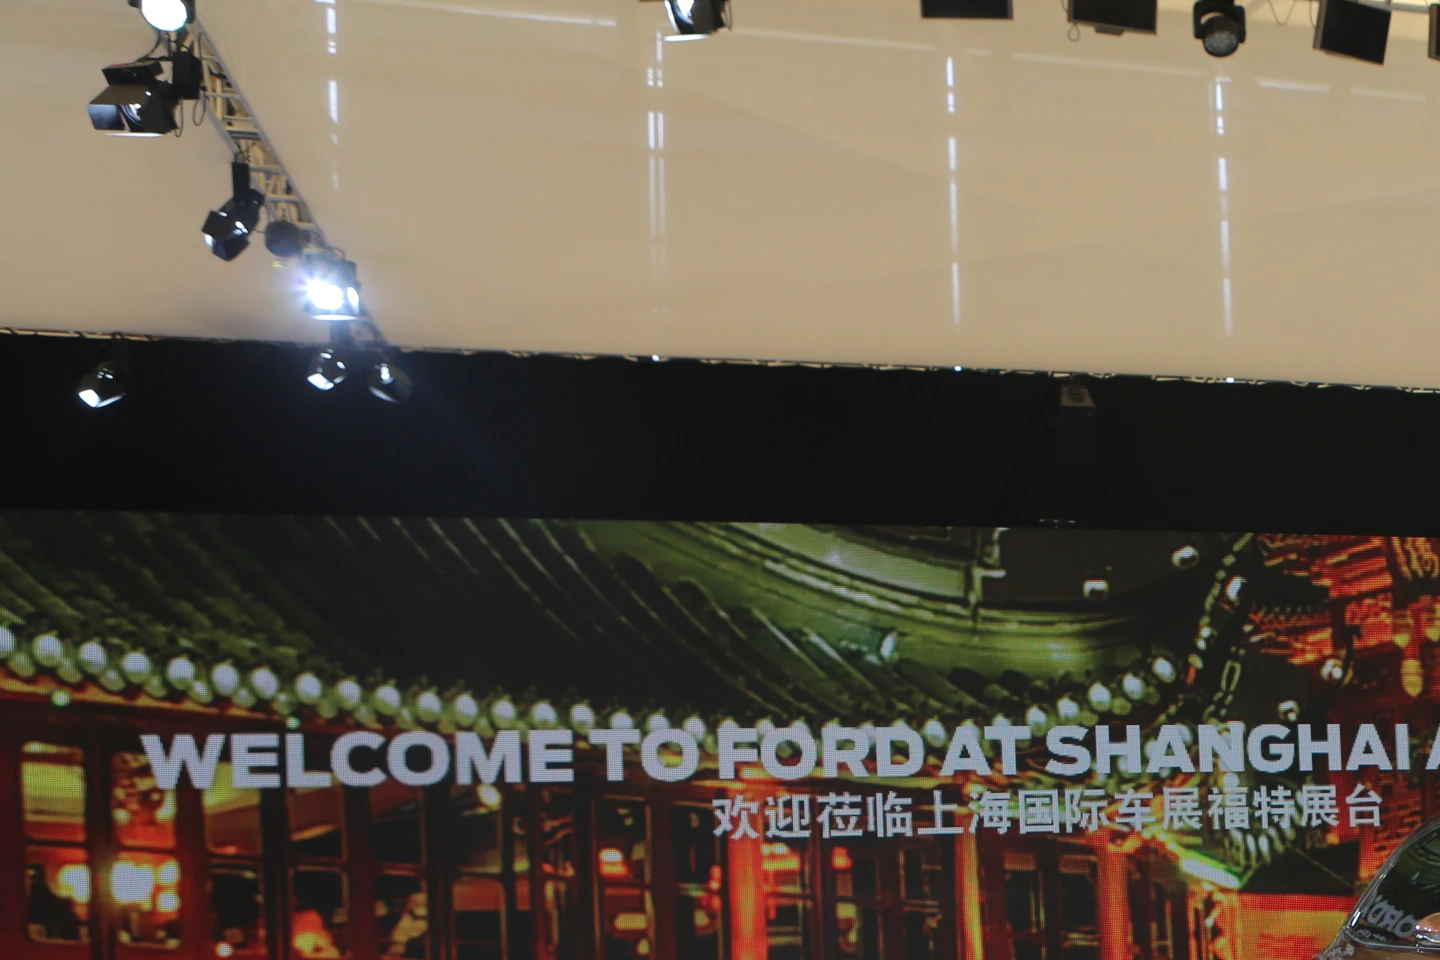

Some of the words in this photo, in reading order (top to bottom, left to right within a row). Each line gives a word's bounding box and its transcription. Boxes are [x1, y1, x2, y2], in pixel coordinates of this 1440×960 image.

[140, 729, 574, 789] WELCOME
[589, 728, 700, 783] TO
[717, 725, 924, 780] FORD
[939, 724, 1031, 776] AT
[1045, 722, 1410, 776] SHANGHAI
[712, 784, 1382, 841] 欢迎莅临上海国际车展福特展台
